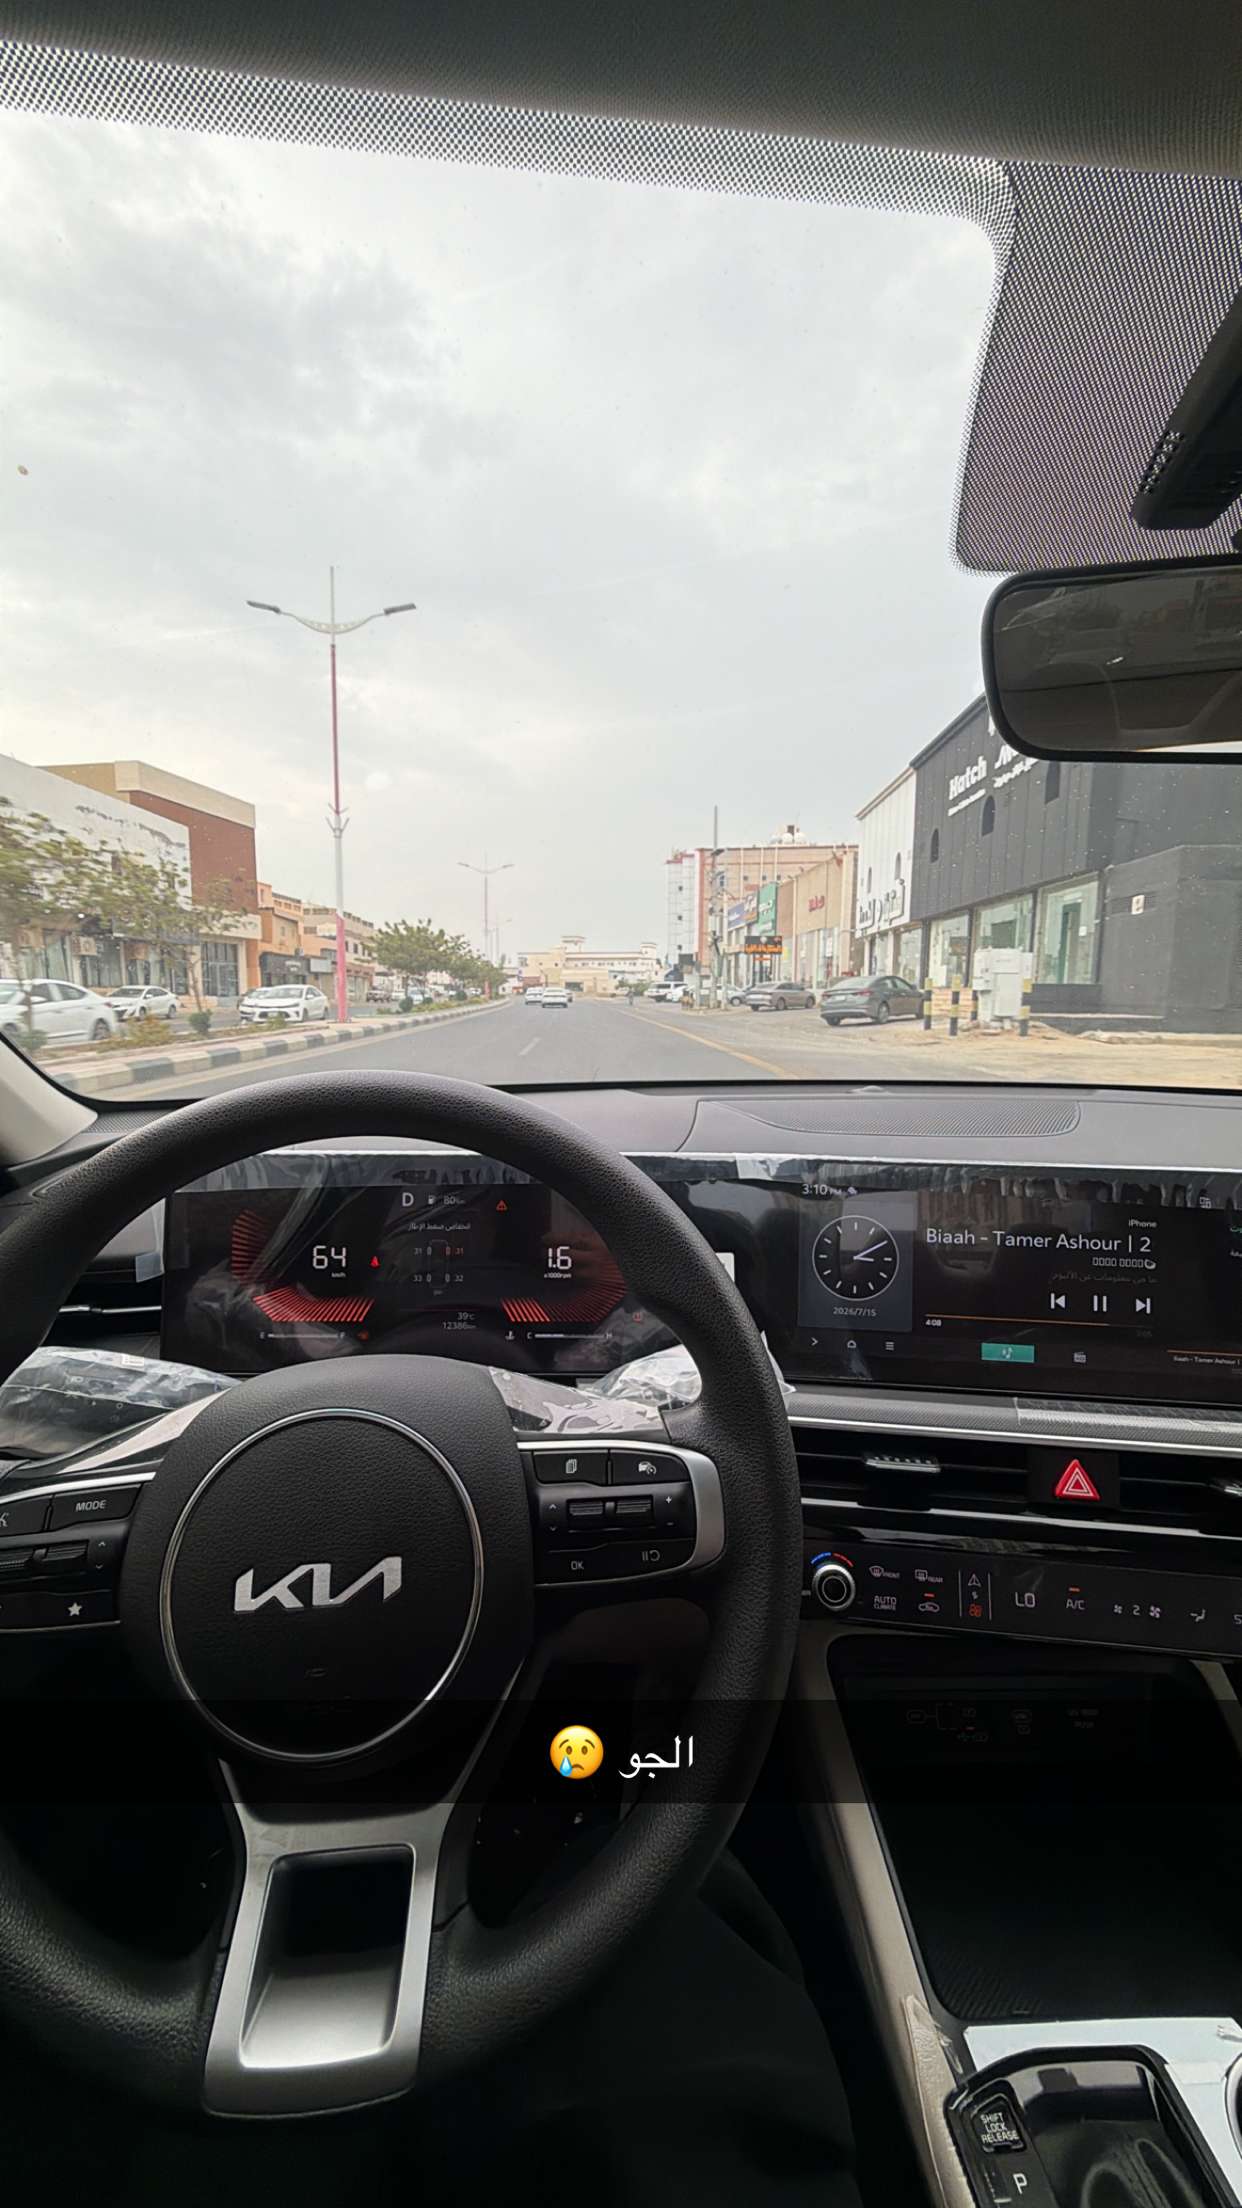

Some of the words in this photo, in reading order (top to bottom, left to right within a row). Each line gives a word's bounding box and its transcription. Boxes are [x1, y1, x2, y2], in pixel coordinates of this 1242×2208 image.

[948, 755, 987, 800] Hatch
[402, 1192, 415, 1207] D
[1128, 1219, 1157, 1228] iPhone
[926, 1228, 975, 1245] Biaah
[992, 1230, 1052, 1248] Tamer
[1056, 1233, 1122, 1251] Ashour
[1139, 1236, 1152, 1252] 2
[312, 1245, 346, 1269] 64
[548, 1246, 572, 1269] 1.6
[75, 1500, 107, 1512] MODE
[571, 1561, 584, 1570] OK
[873, 1595, 897, 1604] AUTO
[1015, 1592, 1036, 1608] LO
[1065, 1599, 1085, 1610] A/C
[1132, 1605, 1141, 1616] 2
[980, 2112, 1004, 2125] SHIFT
[984, 2122, 1008, 2133] LOCK
[981, 2129, 1020, 2144] RELEASE
[1013, 2172, 1028, 2195] P
